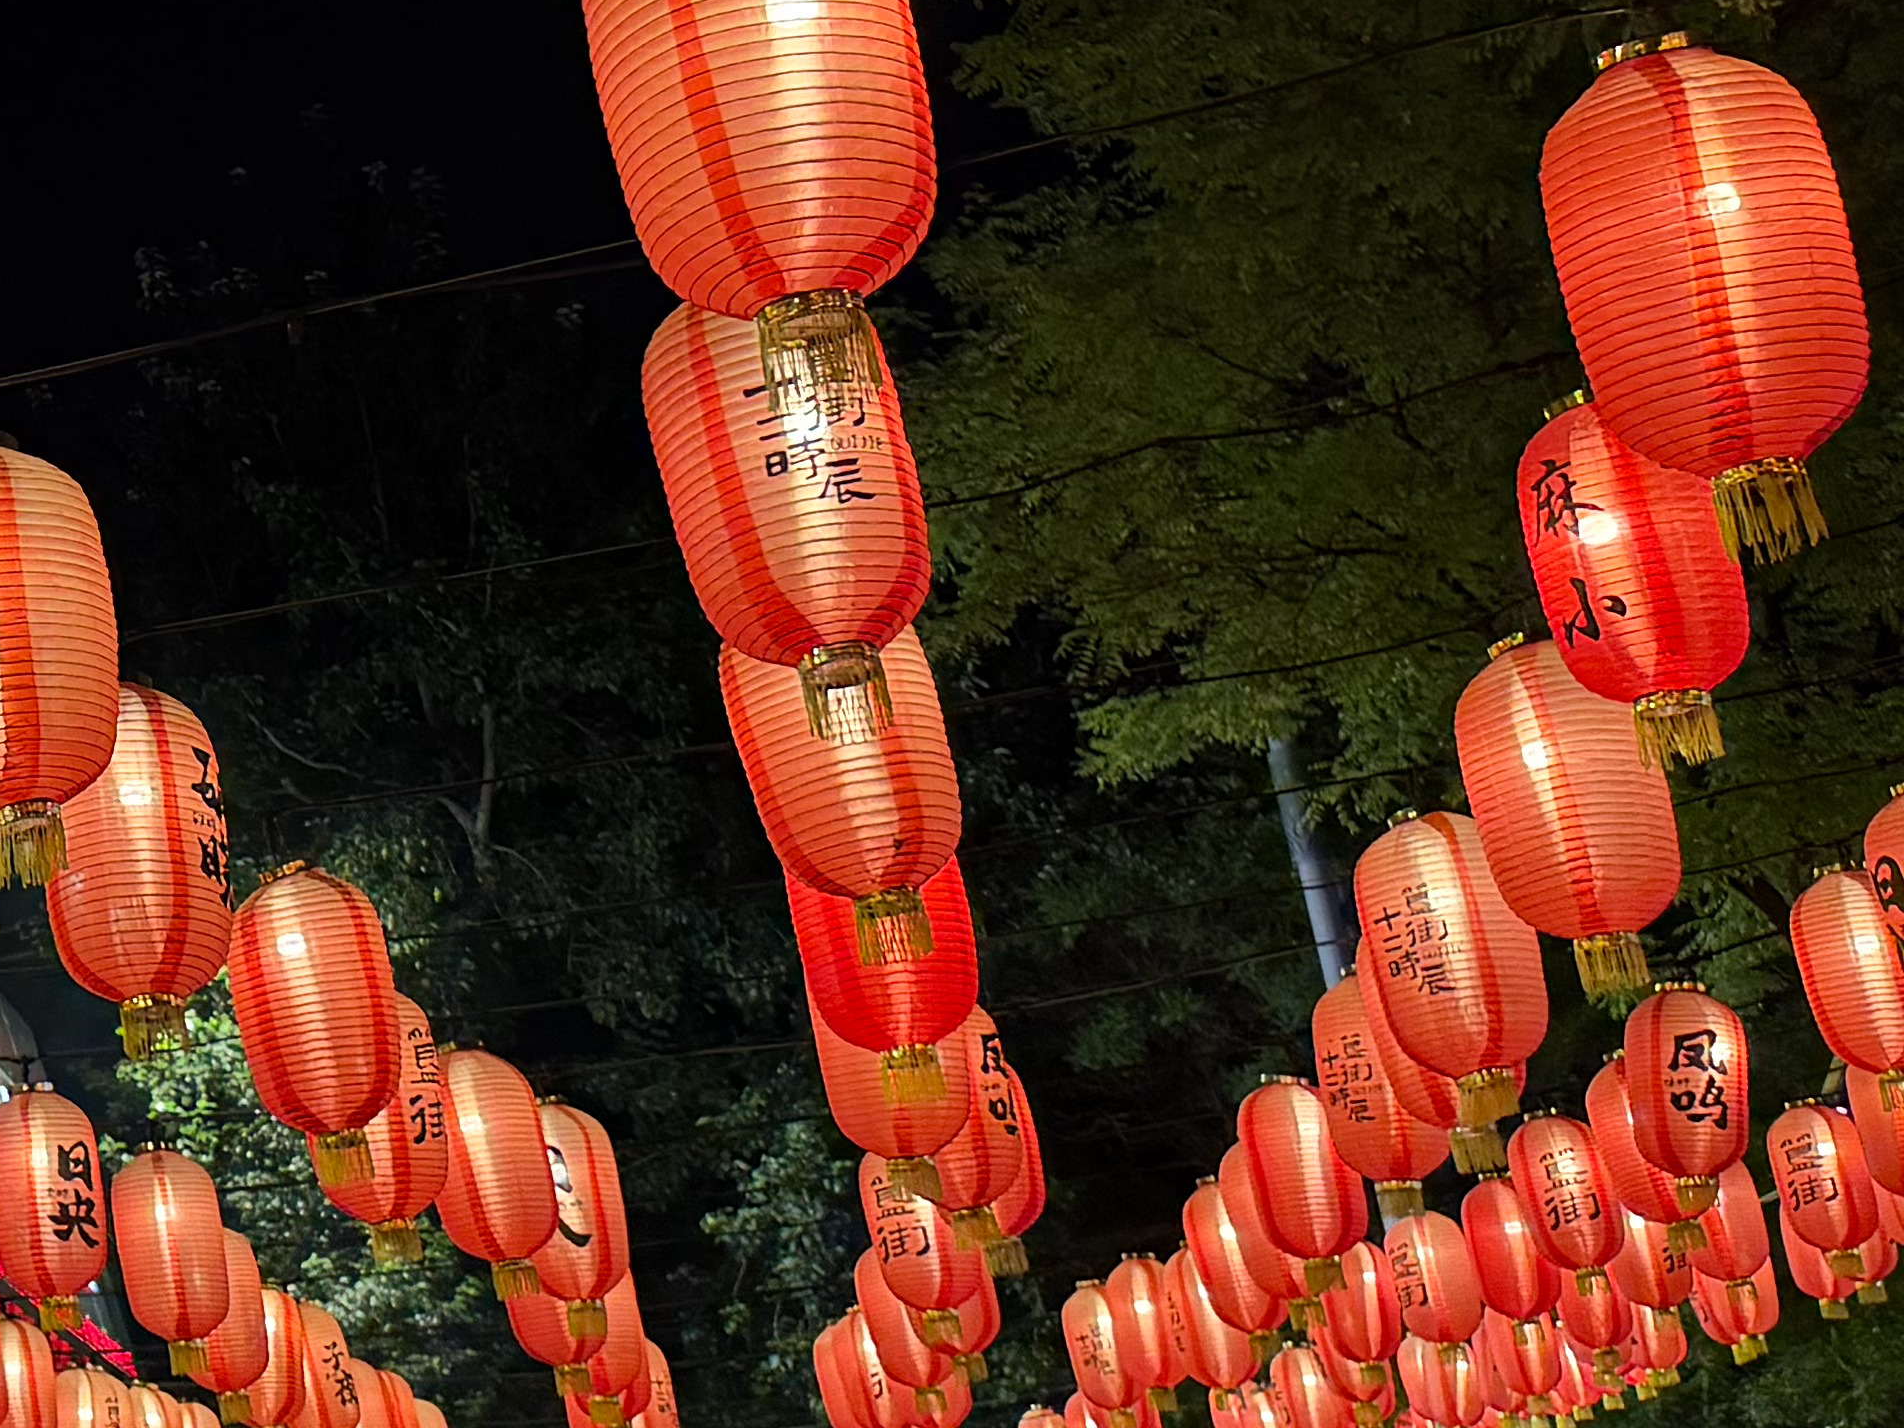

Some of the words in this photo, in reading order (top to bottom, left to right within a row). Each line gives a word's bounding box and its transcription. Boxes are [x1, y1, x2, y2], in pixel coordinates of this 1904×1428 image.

[1530, 459, 1627, 649] 麻小
[46, 1140, 100, 1249] 日央
[1538, 1146, 1602, 1232] 簋街
[1779, 1132, 1839, 1213] 簋街
